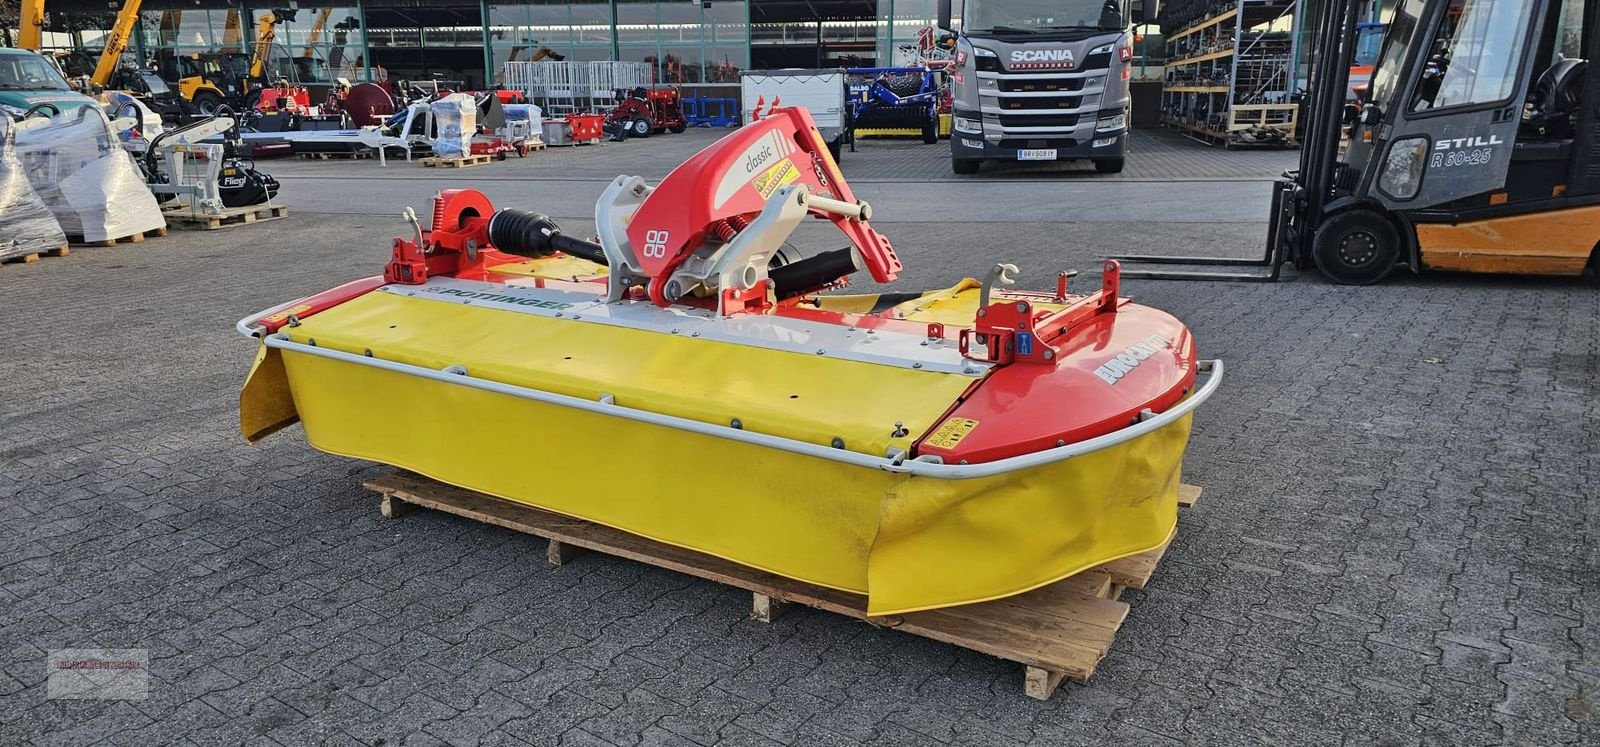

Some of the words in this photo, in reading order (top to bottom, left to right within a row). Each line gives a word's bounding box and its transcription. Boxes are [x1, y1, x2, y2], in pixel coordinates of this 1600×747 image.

[1011, 50, 1073, 61] SCANIA
[1435, 135, 1503, 150] STILL
[746, 145, 772, 173] classic
[1431, 152, 1444, 168] R
[1445, 148, 1492, 167] 60-25
[225, 176, 246, 187] Fliegl
